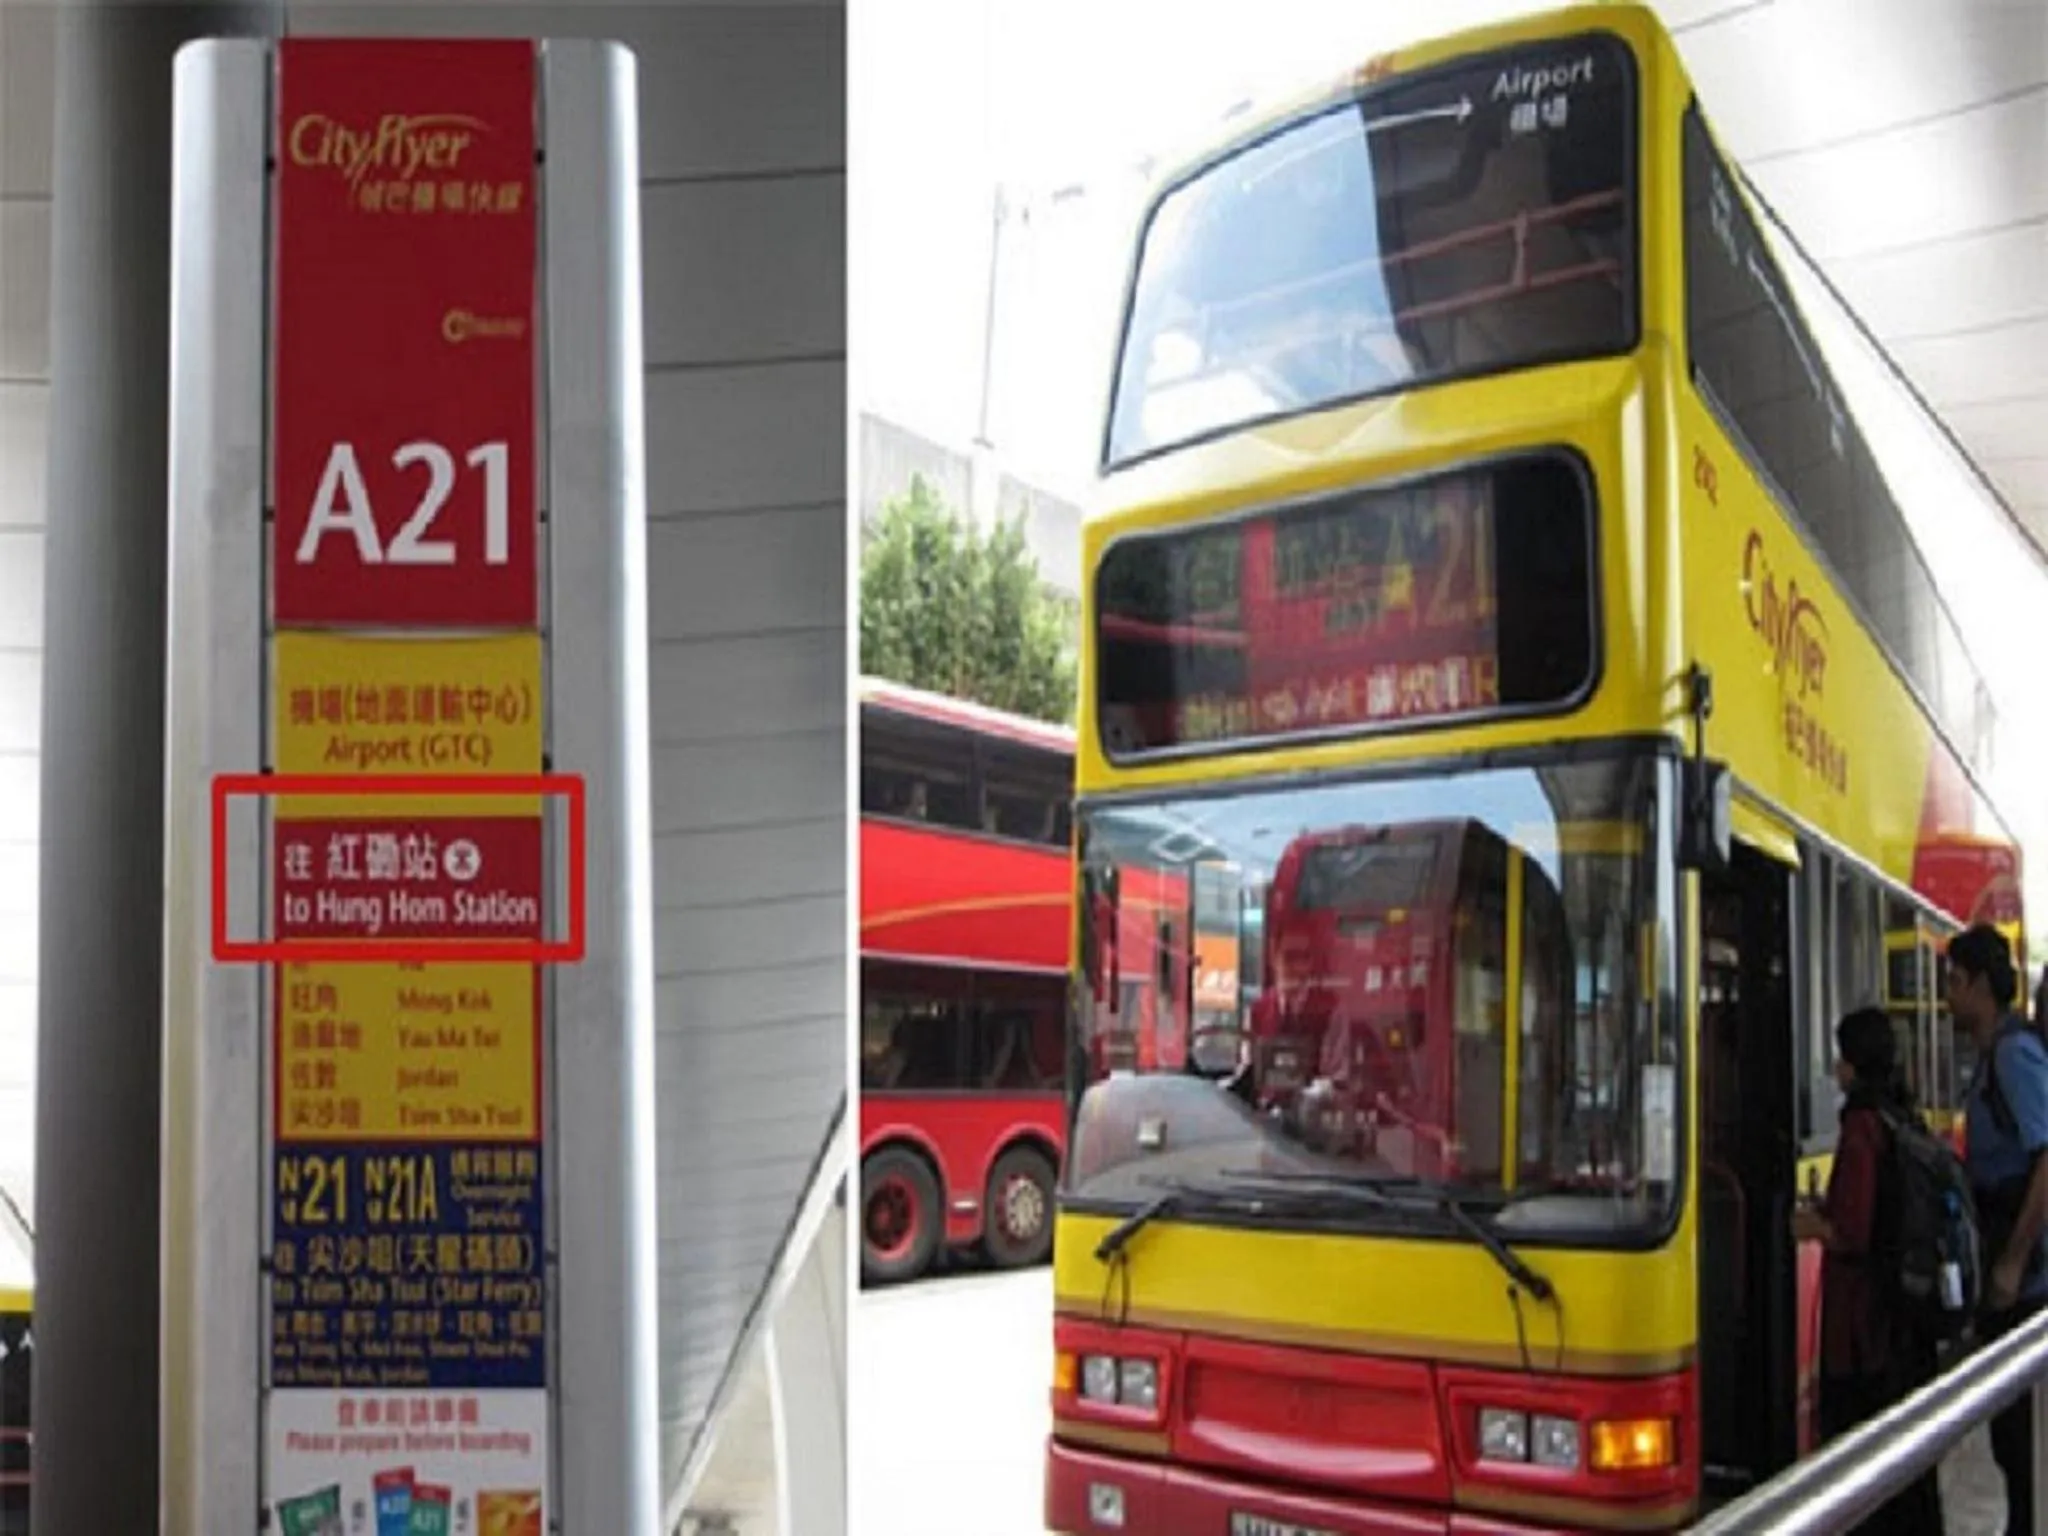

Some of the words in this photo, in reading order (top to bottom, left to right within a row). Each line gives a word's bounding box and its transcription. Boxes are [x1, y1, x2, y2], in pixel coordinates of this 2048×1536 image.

[1491, 55, 1594, 102] Airport
[295, 440, 509, 565] A21
[325, 735, 412, 769] Airport
[421, 732, 494, 766] (GTC)
[284, 891, 310, 922] to
[316, 890, 383, 934] Hung
[388, 890, 446, 923] Hom
[453, 889, 538, 923] Station
